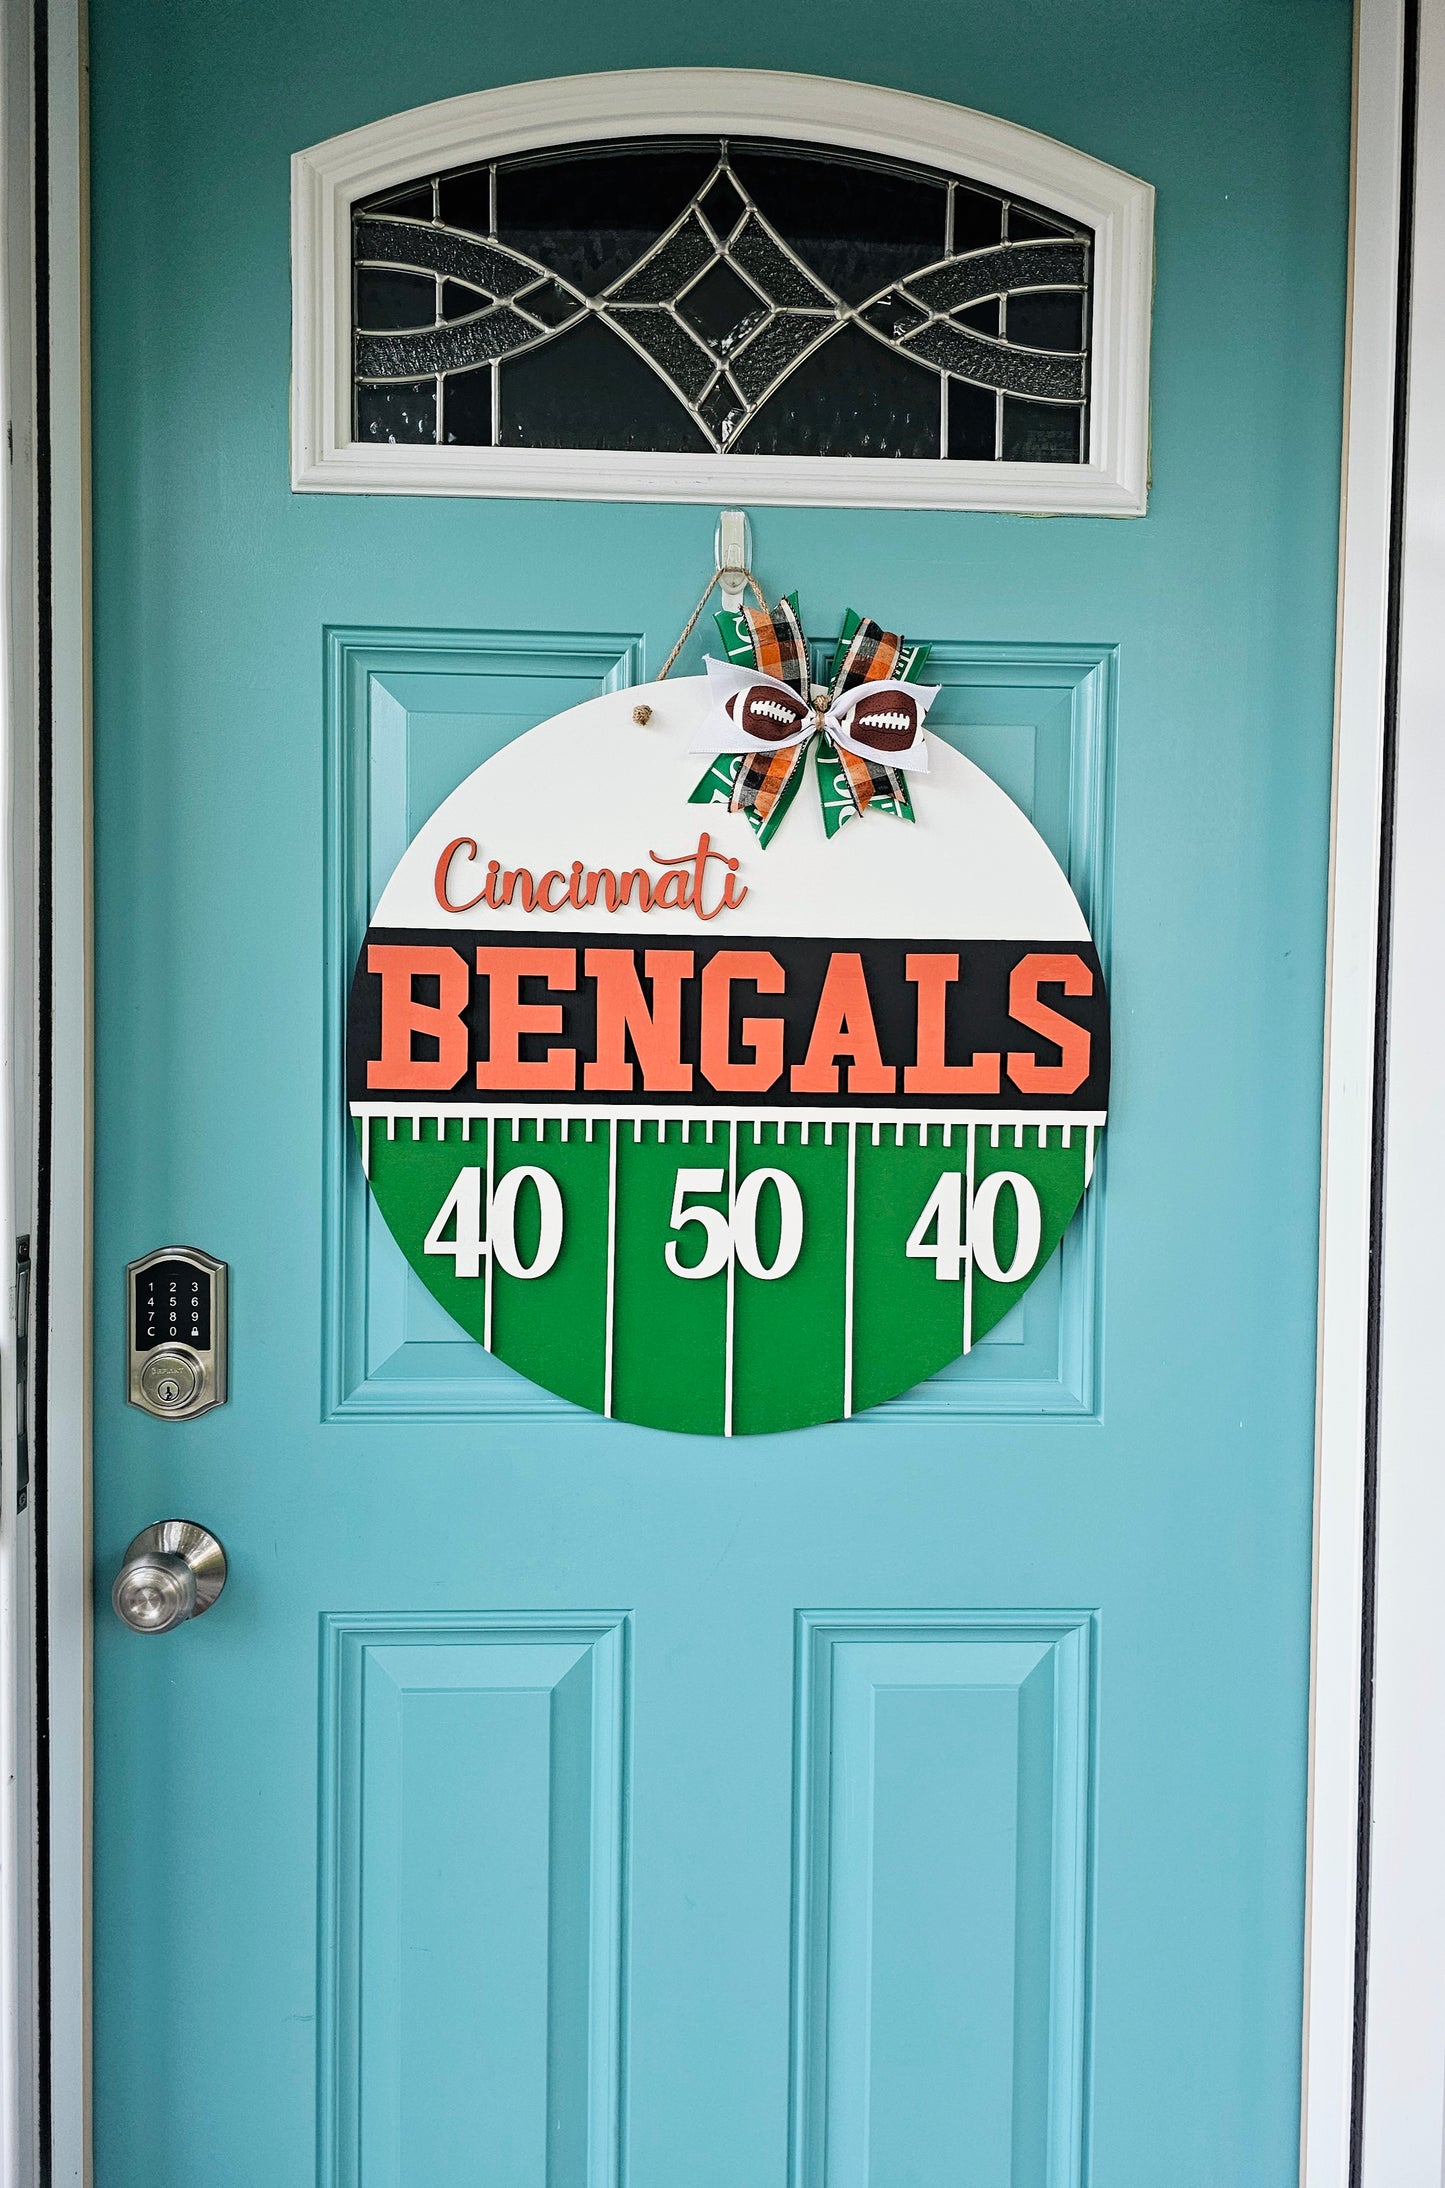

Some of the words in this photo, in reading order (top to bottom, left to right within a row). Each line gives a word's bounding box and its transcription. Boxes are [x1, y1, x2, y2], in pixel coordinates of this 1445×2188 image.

[434, 832, 749, 920] Cincinnati
[366, 944, 1094, 1095] BENGALS
[423, 1165, 563, 1280] 40
[664, 1167, 804, 1281] 50
[905, 1170, 1042, 1284] 40
[148, 1282, 154, 1292] 1
[169, 1282, 177, 1292] 2
[191, 1282, 199, 1292] 3
[147, 1297, 155, 1307] 4
[169, 1297, 177, 1307] 5
[191, 1297, 199, 1307] 6
[148, 1312, 155, 1322] 7
[169, 1312, 177, 1322] 8
[191, 1312, 199, 1322] 9
[147, 1326, 156, 1337] C
[169, 1326, 177, 1337] 0
